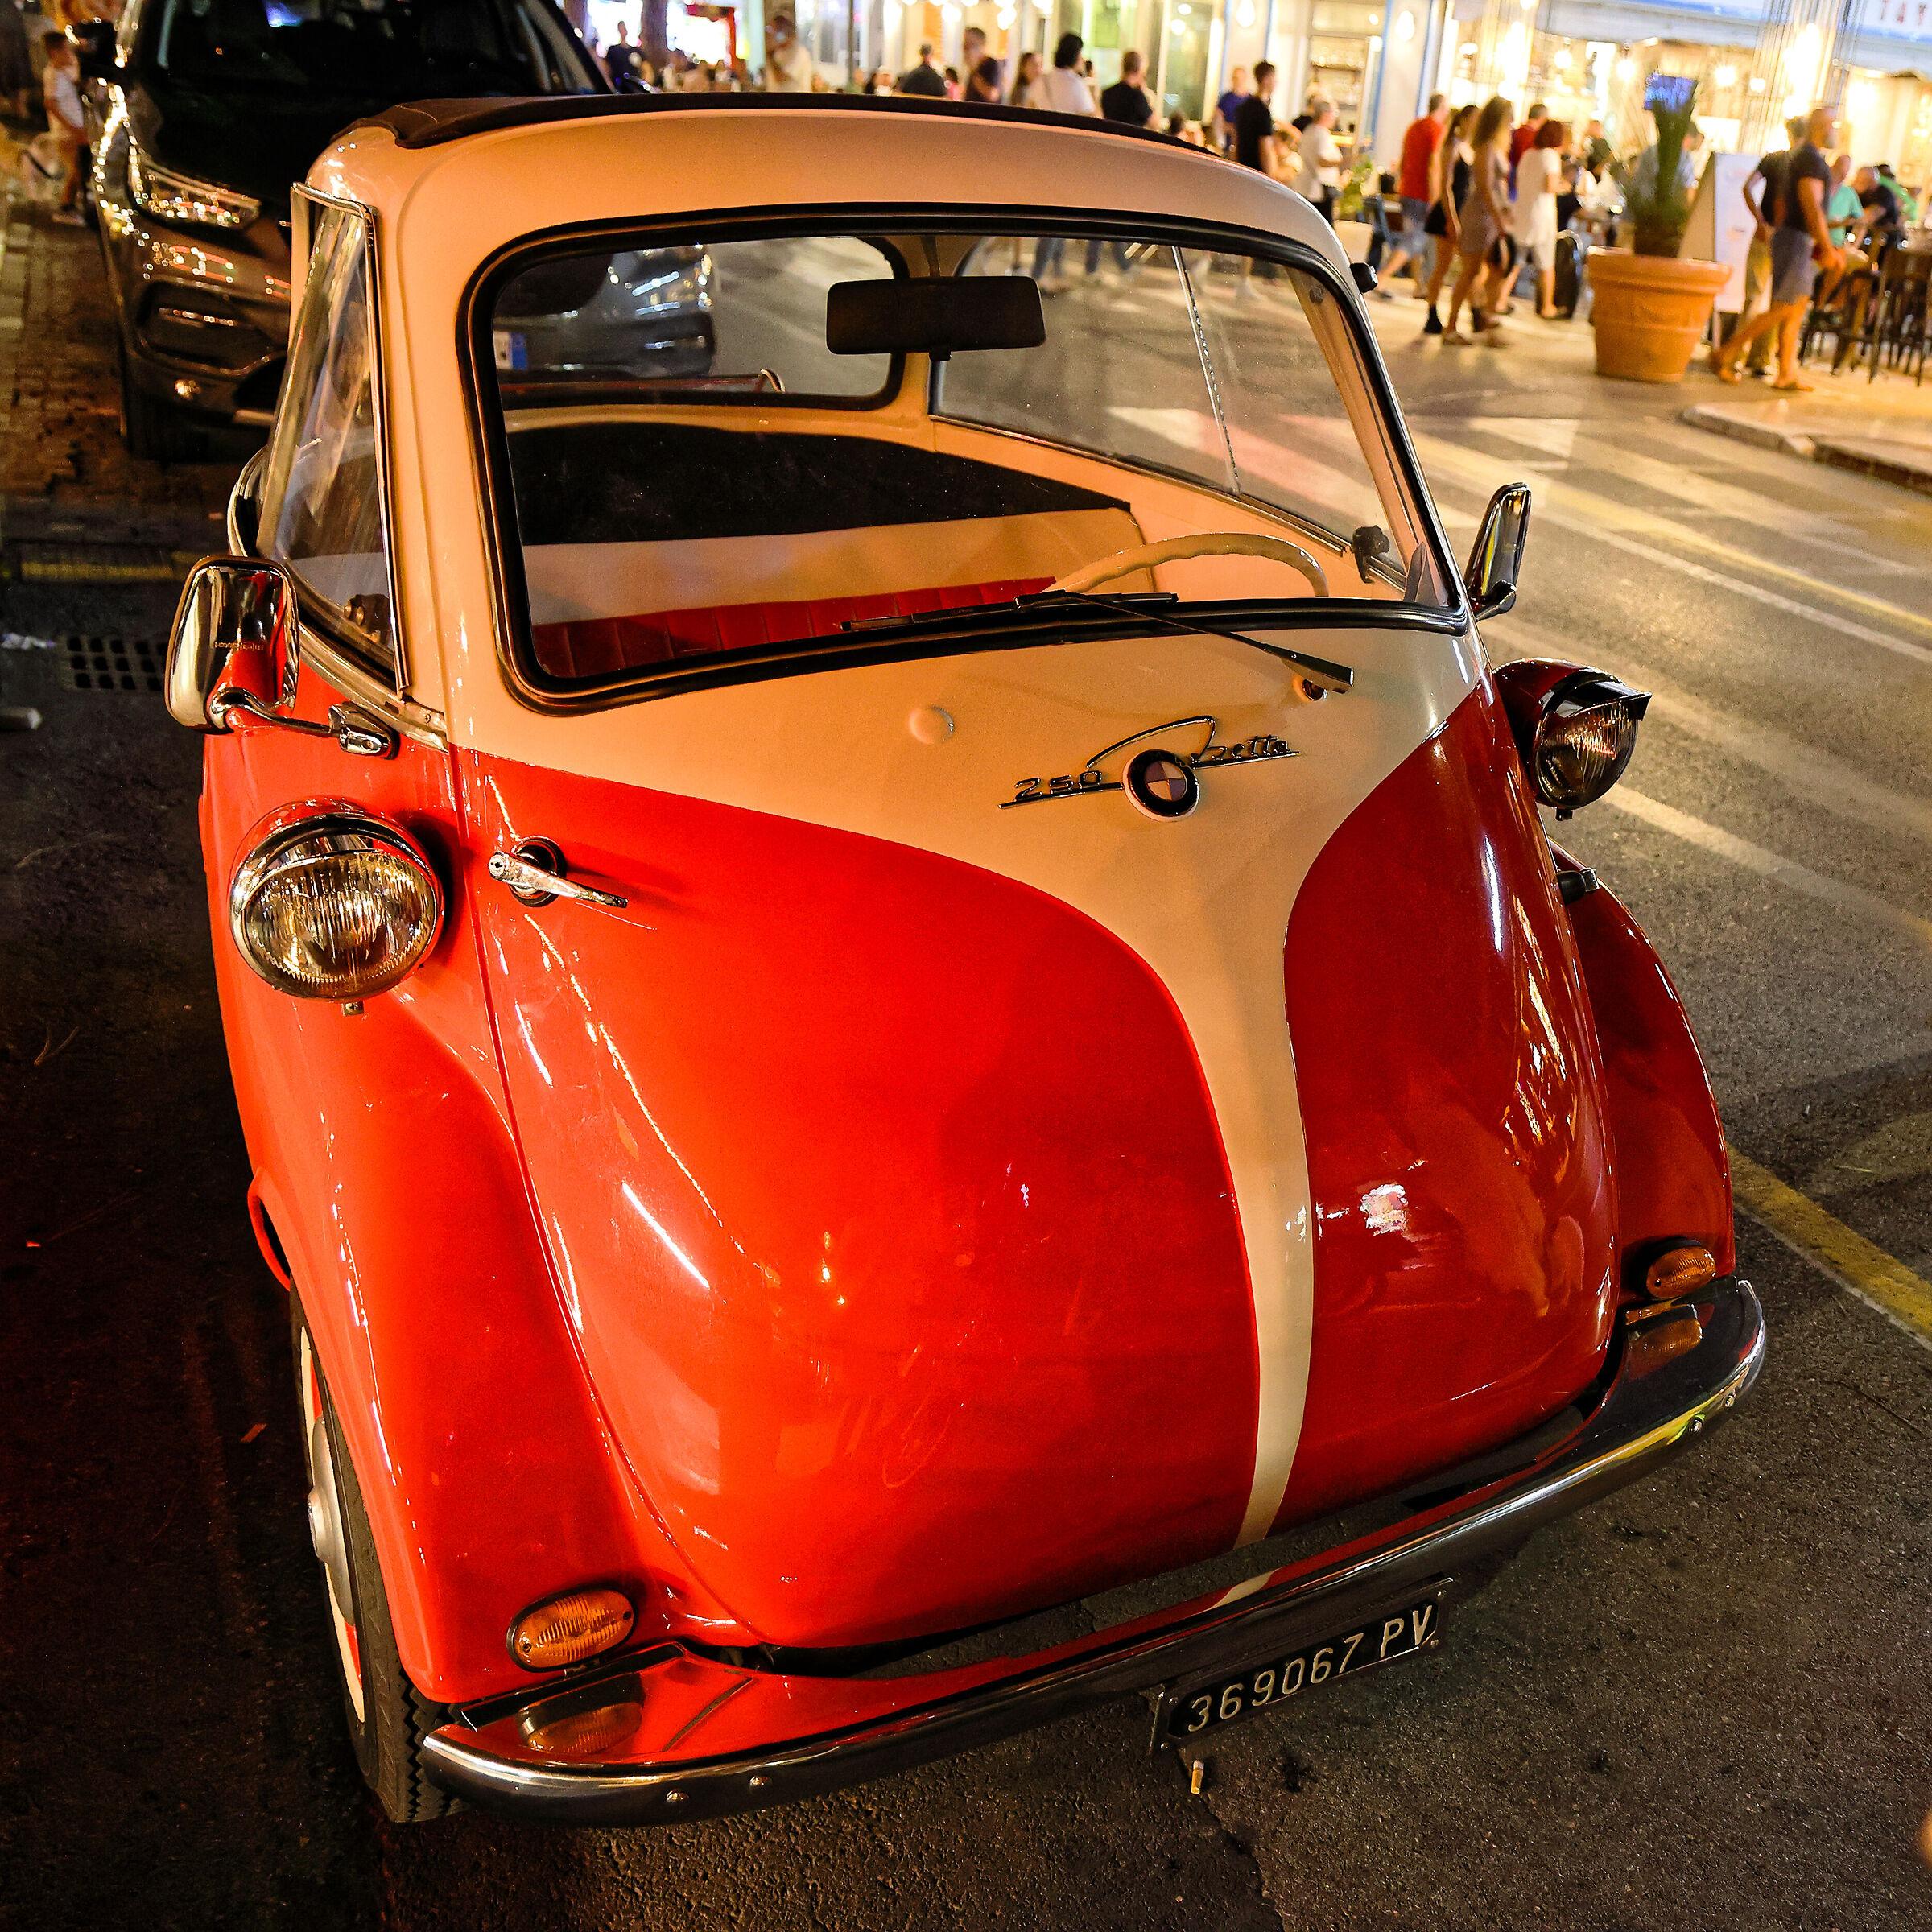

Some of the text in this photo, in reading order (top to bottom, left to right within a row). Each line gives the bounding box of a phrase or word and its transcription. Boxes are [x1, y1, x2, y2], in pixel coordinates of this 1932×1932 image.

[1013, 770, 1103, 801] 250
[1188, 1604, 1432, 1732] 369067 PV
